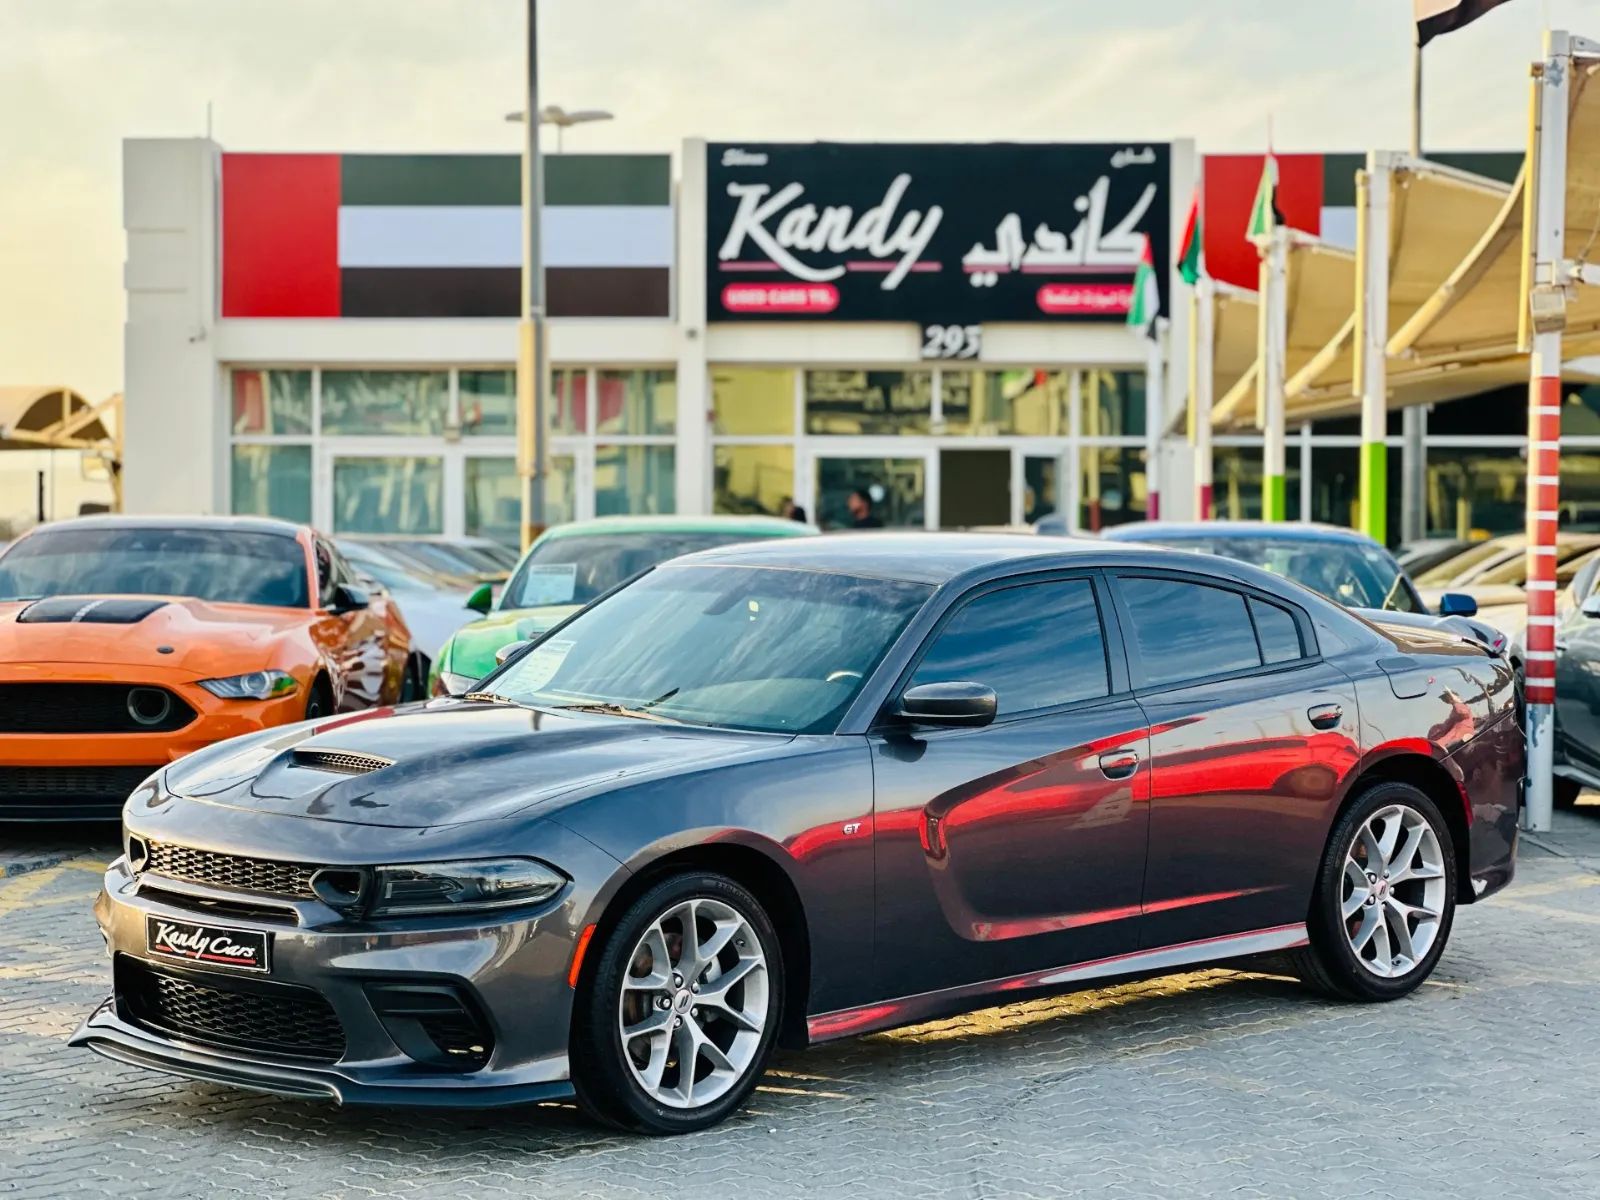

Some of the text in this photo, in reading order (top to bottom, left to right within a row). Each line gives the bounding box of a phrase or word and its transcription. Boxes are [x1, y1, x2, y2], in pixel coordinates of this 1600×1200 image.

[718, 173, 943, 290] Kandy
[962, 175, 1157, 288] كاندي
[921, 324, 982, 358] 295
[843, 823, 861, 834] GT
[155, 921, 256, 959] Kandy Cars
